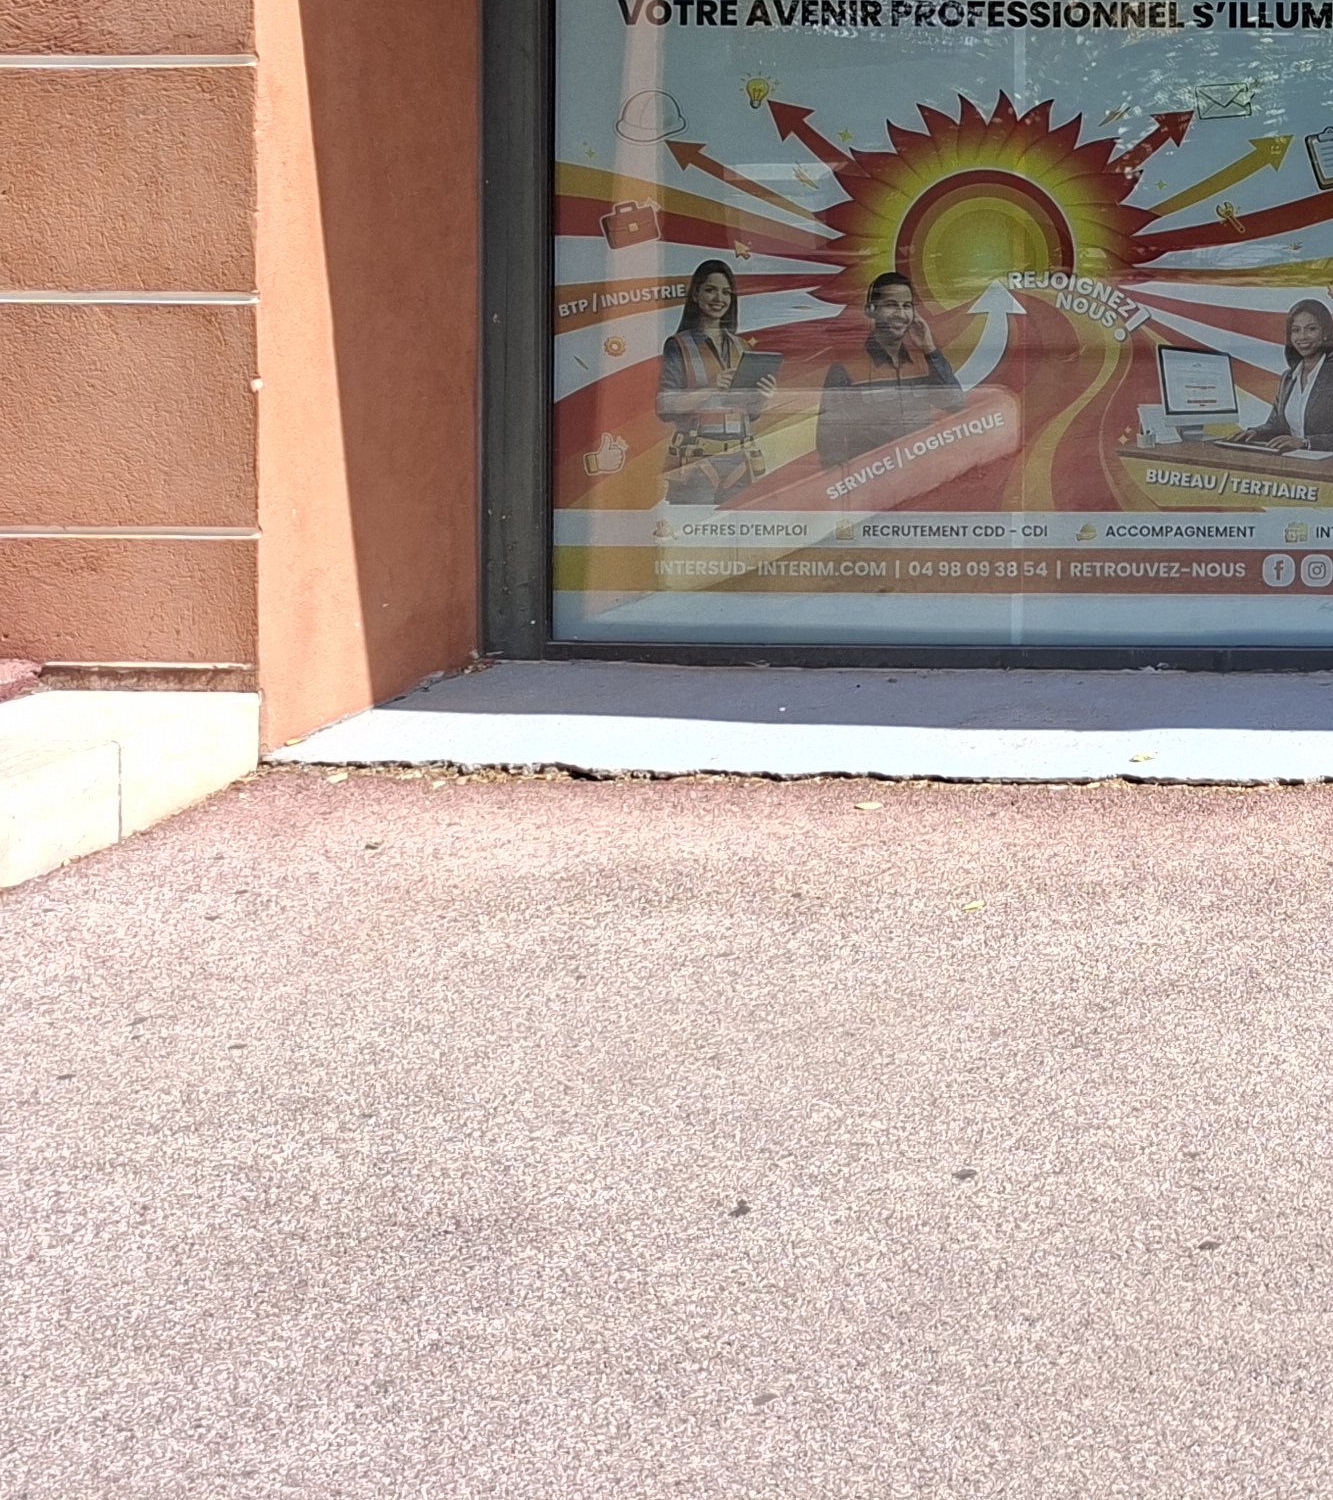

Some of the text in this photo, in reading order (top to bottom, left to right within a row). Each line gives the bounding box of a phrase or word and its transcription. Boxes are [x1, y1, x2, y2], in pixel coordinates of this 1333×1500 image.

[890, 0, 1184, 30] PROFESSIONNEL
[558, 299, 588, 317] BTP
[601, 284, 687, 308] INDUSTRIE
[1008, 271, 1138, 318] REJOIGNEZ
[1056, 292, 1117, 328] NOUS
[826, 456, 895, 500] SERVICE
[904, 412, 1005, 460] LOGISTIQUE
[1145, 468, 1217, 490] BUREAU
[1230, 477, 1319, 501] TERTIAIRE
[682, 524, 736, 537] OFFRES
[862, 524, 969, 538] RECRUTEMENT
[972, 525, 1005, 538] CDD
[1021, 524, 1048, 538] CDI
[1105, 524, 1256, 538] ACCOMPAGNEMENT
[908, 561, 933, 576] 04
[938, 561, 962, 576] 98
[966, 561, 991, 576] 09
[995, 561, 1018, 576] 38
[1023, 561, 1048, 577] 54
[1070, 561, 1246, 578] RETROUVEZ-NOUS
